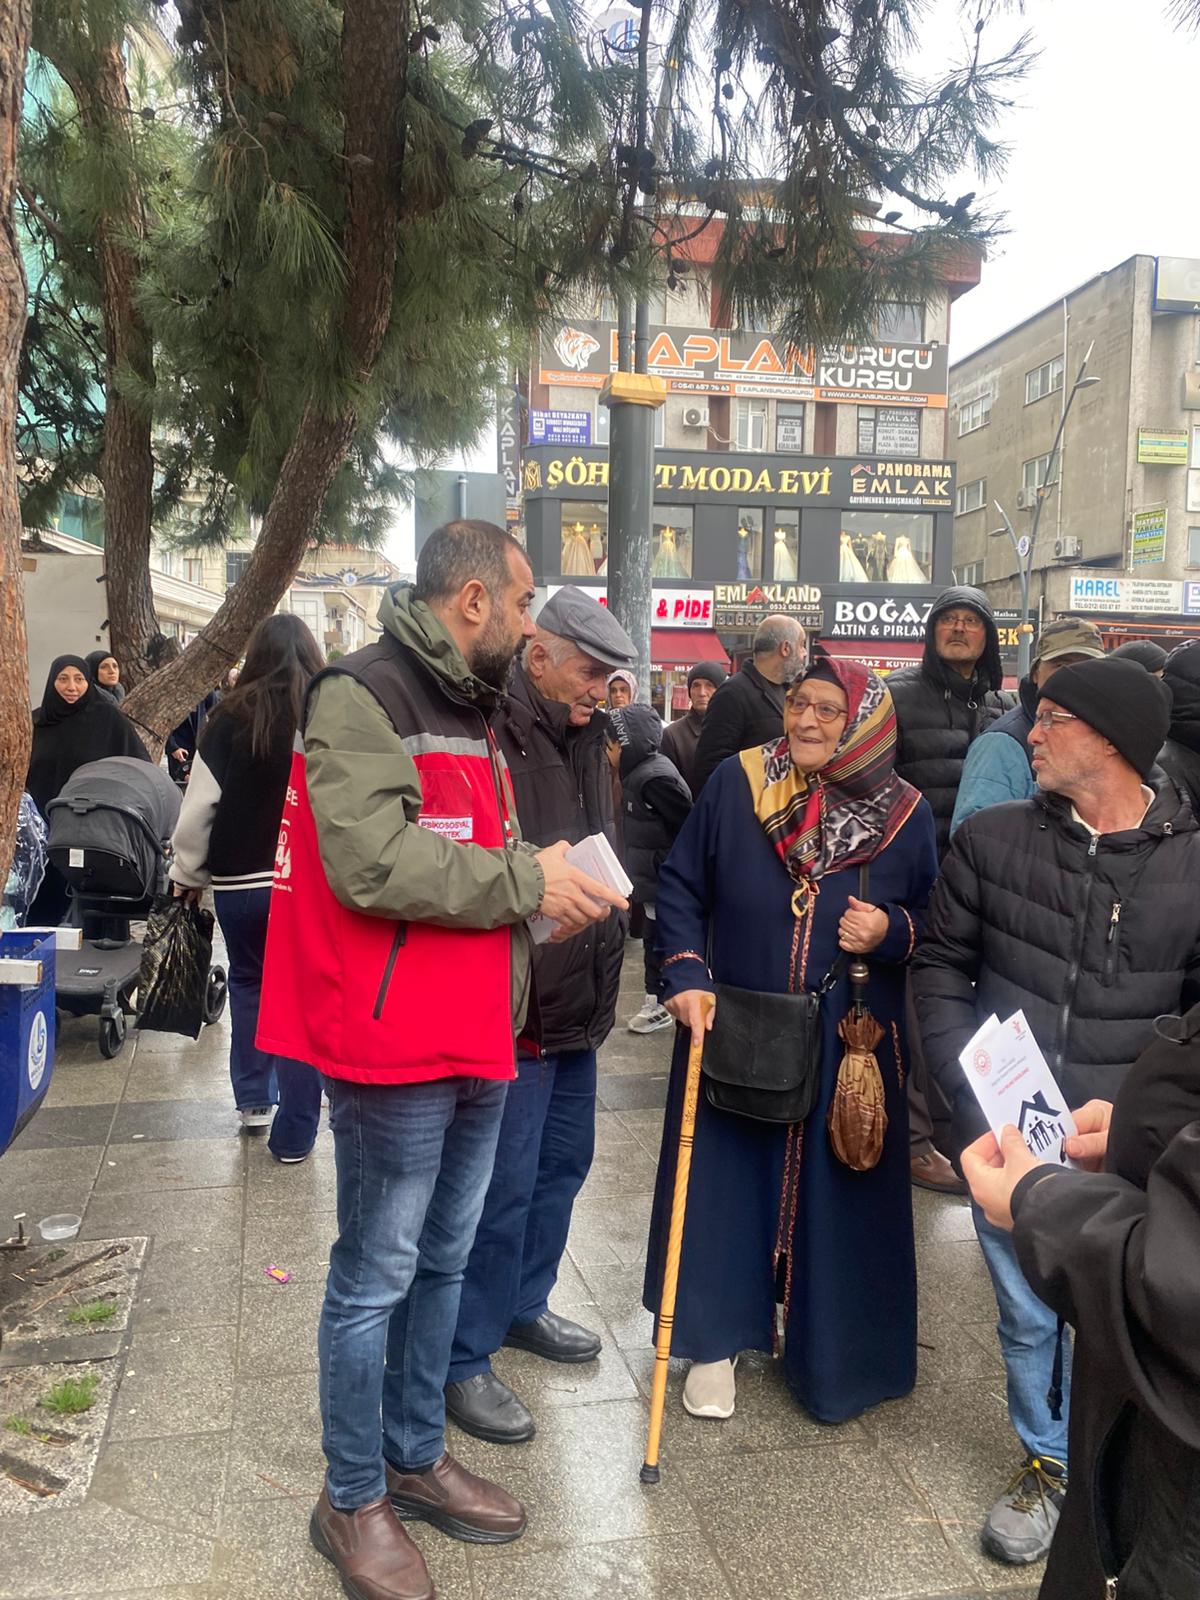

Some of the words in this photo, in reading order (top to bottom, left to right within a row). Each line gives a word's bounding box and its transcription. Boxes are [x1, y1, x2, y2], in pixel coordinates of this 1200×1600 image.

[820, 344, 933, 370] SÜRÜCÜ
[819, 366, 913, 391] KURSU
[500, 407, 517, 496] KAPLAN
[546, 456, 677, 490] ŞÖHT
[678, 466, 775, 493] MODA
[778, 465, 833, 496] EVİ
[877, 463, 952, 478] PANORAMA
[853, 478, 949, 496] EMLAK
[1074, 579, 1120, 597] KAREL
[656, 598, 668, 618] &
[673, 594, 711, 620] PİDE
[835, 598, 934, 624] BOĞAZ
[831, 623, 867, 636] ALTIN
[870, 624, 880, 636] &
[883, 624, 927, 637] PIRLAN
[421, 820, 470, 830] PSİKOSOSYAL
